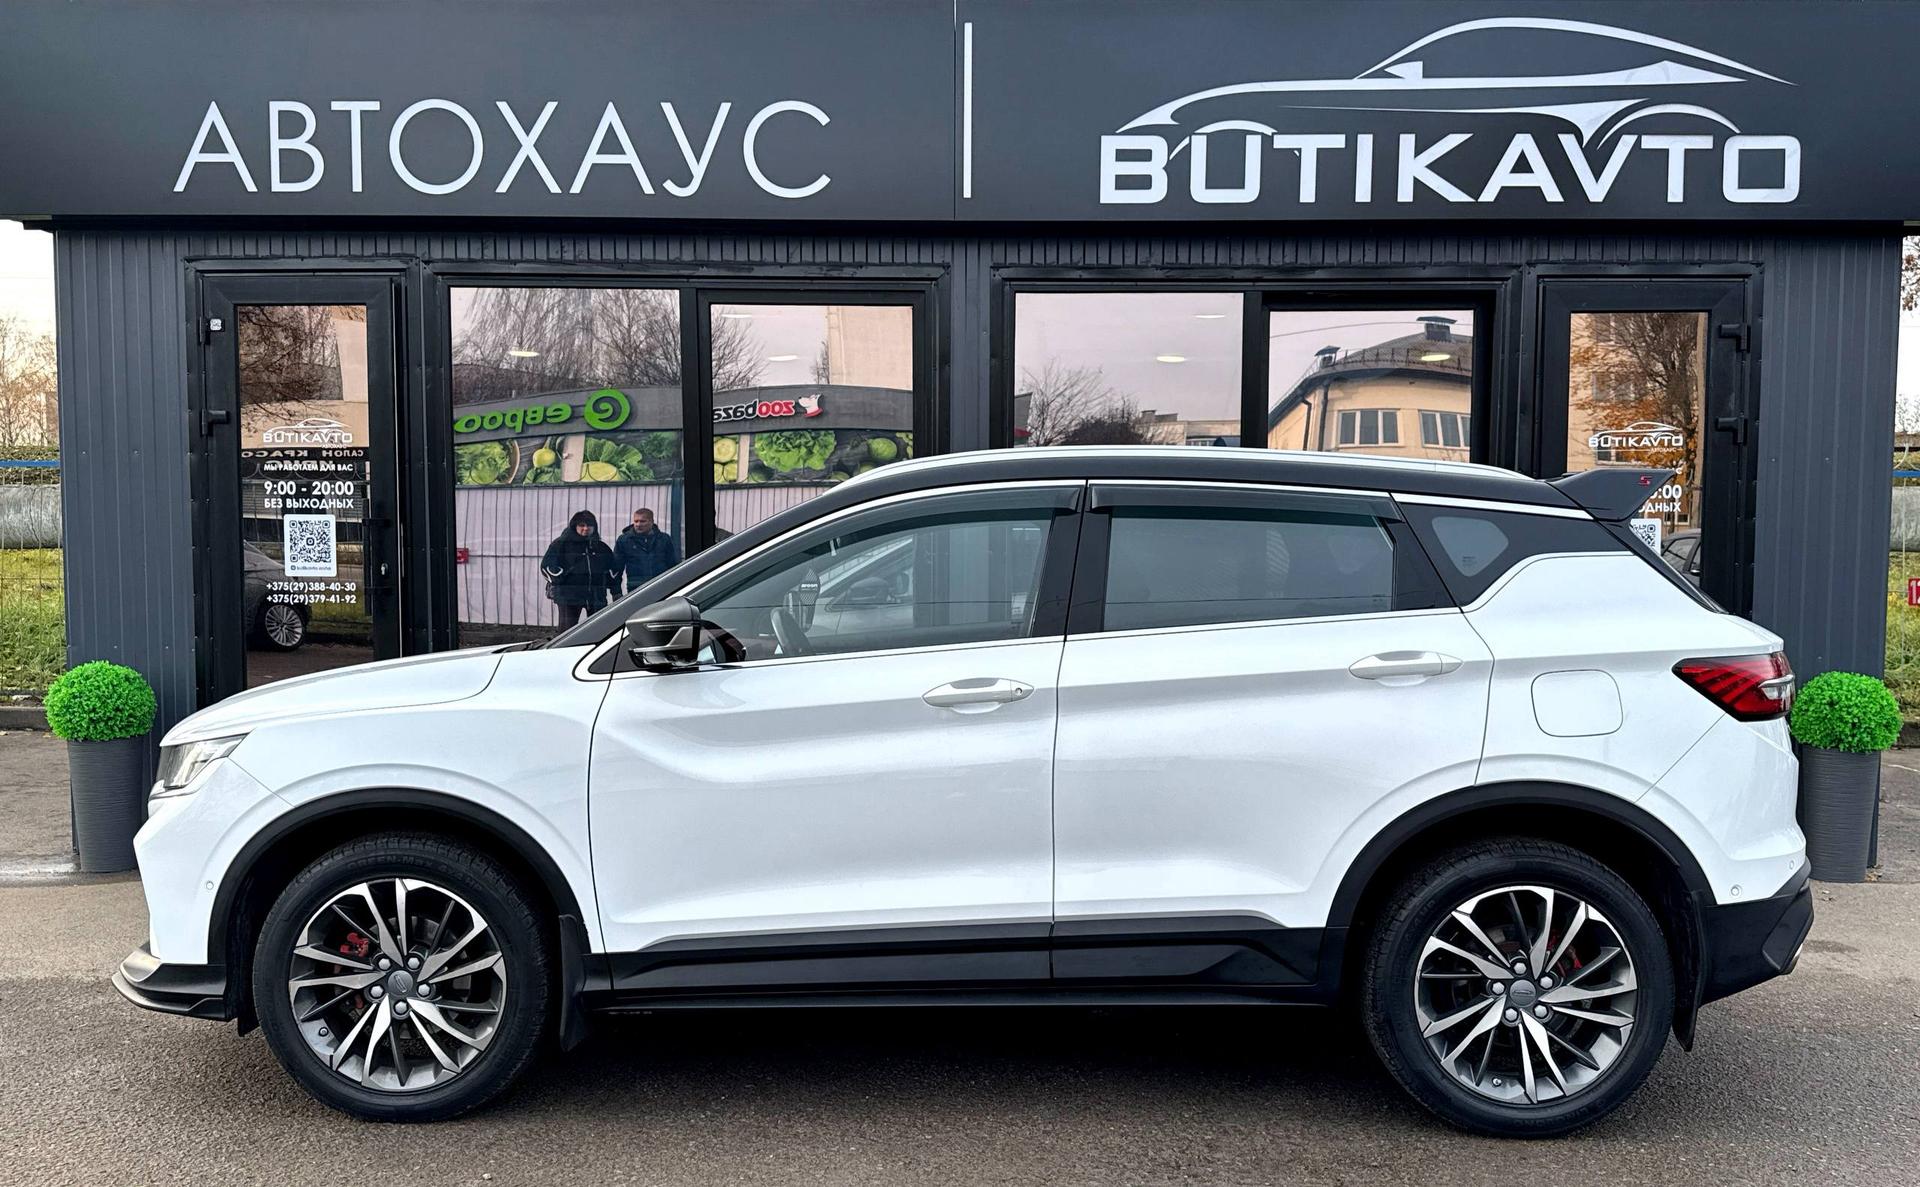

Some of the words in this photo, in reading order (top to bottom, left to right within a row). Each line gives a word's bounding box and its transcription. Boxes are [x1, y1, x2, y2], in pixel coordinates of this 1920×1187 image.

[173, 98, 831, 199] АВТОХАУС
[1099, 133, 1801, 205] BUTIKAVTO
[263, 432, 353, 443] BUTIKAVTO
[1588, 436, 1684, 448] BUTIKAVTO
[320, 464, 336, 472] ДЛЯ
[264, 481, 297, 495] 9:00
[312, 481, 355, 495] 20:00
[264, 498, 283, 508] БЕЗ
[286, 498, 354, 509] ВЫХОДНЫХ
[266, 582, 357, 593] +375(29)388-40-30
[266, 594, 357, 605] +375(29)379-41-92
